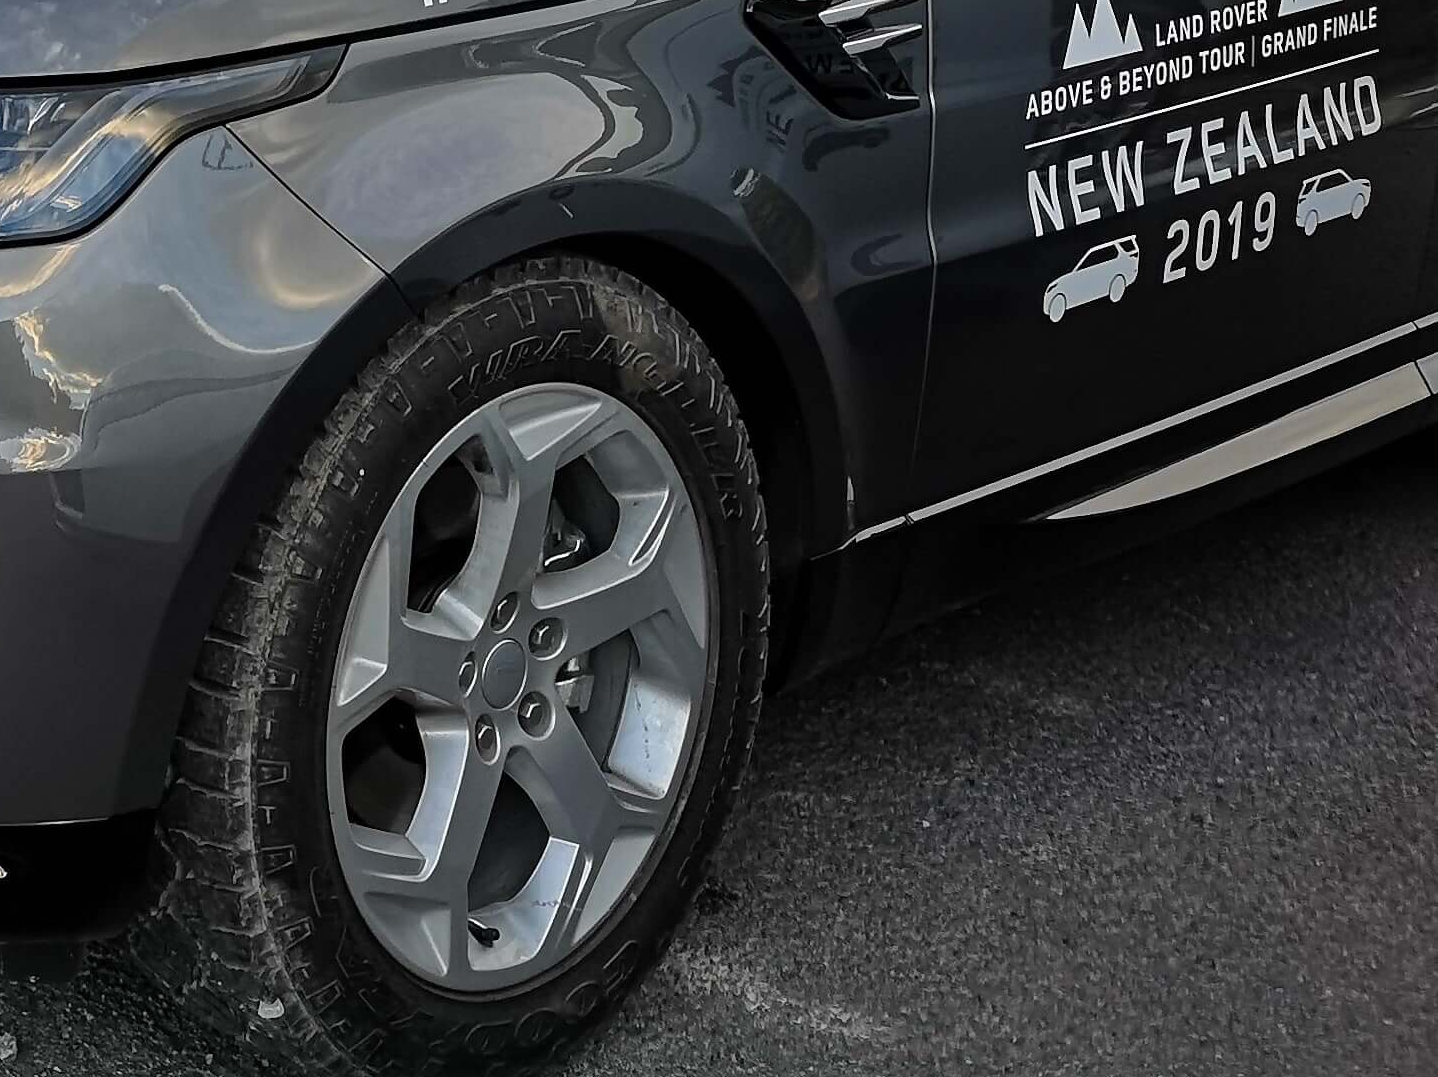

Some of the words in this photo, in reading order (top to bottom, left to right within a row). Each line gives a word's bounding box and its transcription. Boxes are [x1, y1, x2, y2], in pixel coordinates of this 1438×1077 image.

[1025, 80, 1093, 120] ABOVE
[1100, 74, 1112, 101] &
[1119, 55, 1194, 97] BEYOND
[1199, 41, 1246, 74] TOUR
[1261, 21, 1318, 58] GRAND
[1322, 6, 1378, 41] FINALE
[1155, 14, 1204, 48] LAND
[1025, 140, 1146, 238] NEW
[1166, 75, 1383, 196] ZEALAND
[1162, 191, 1277, 284] 2019
